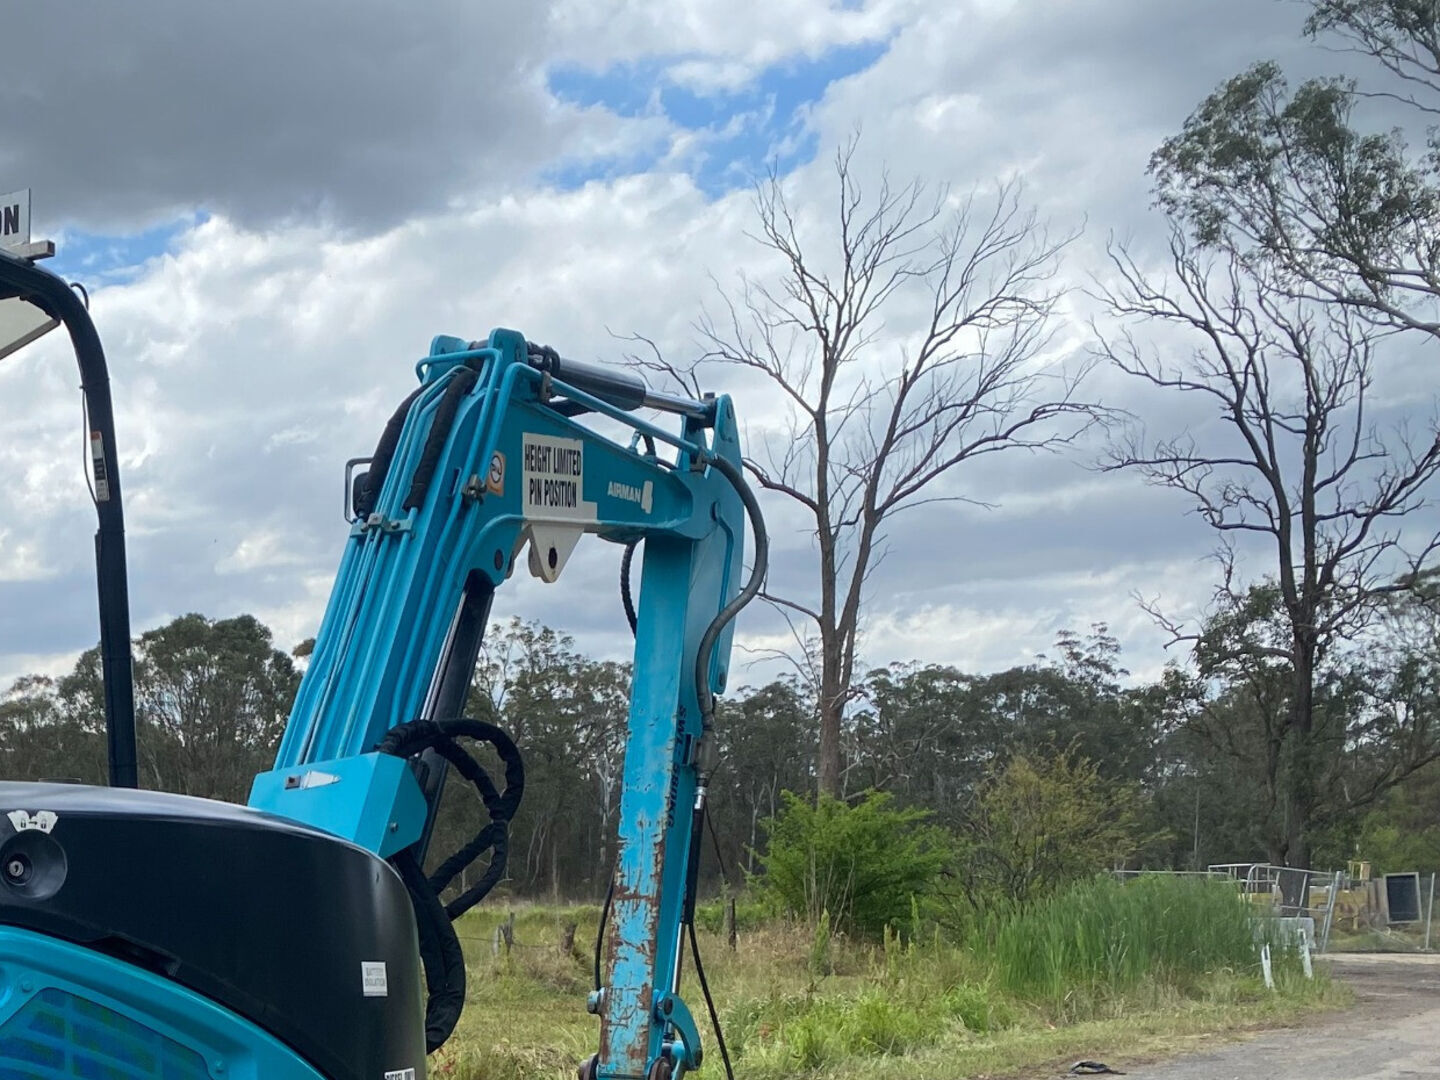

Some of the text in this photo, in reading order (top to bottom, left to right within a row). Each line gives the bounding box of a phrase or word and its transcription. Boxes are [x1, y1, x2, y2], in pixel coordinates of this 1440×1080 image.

[524, 444, 582, 476] HEIGHT LIMITED
[529, 478, 577, 508] PIN POSITION
[607, 480, 642, 503] AIRMAN
